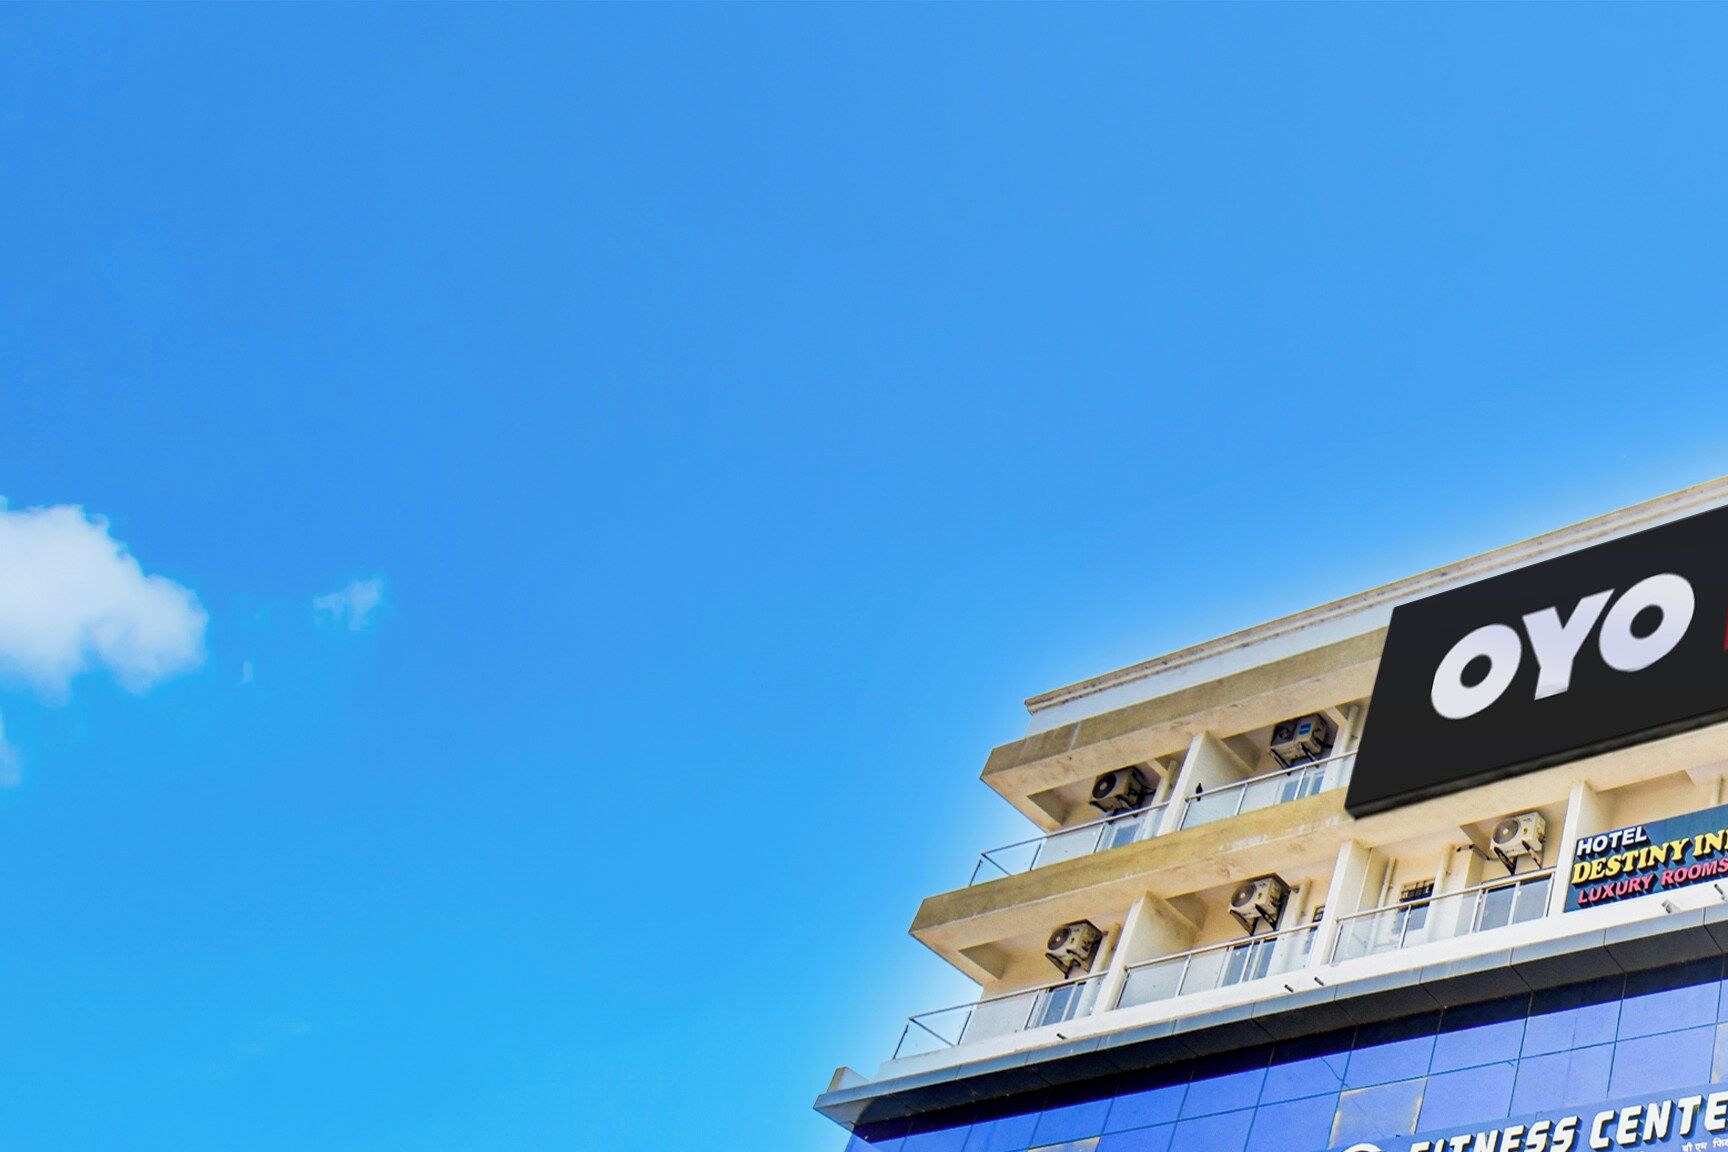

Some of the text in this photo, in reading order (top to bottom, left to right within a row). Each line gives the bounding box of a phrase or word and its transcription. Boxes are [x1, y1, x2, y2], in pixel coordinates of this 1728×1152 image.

[1431, 572, 1695, 720] OYO
[1576, 826, 1647, 857] HOTEL
[1572, 838, 1688, 885] DESTINY
[1578, 874, 1655, 905] LUXURY
